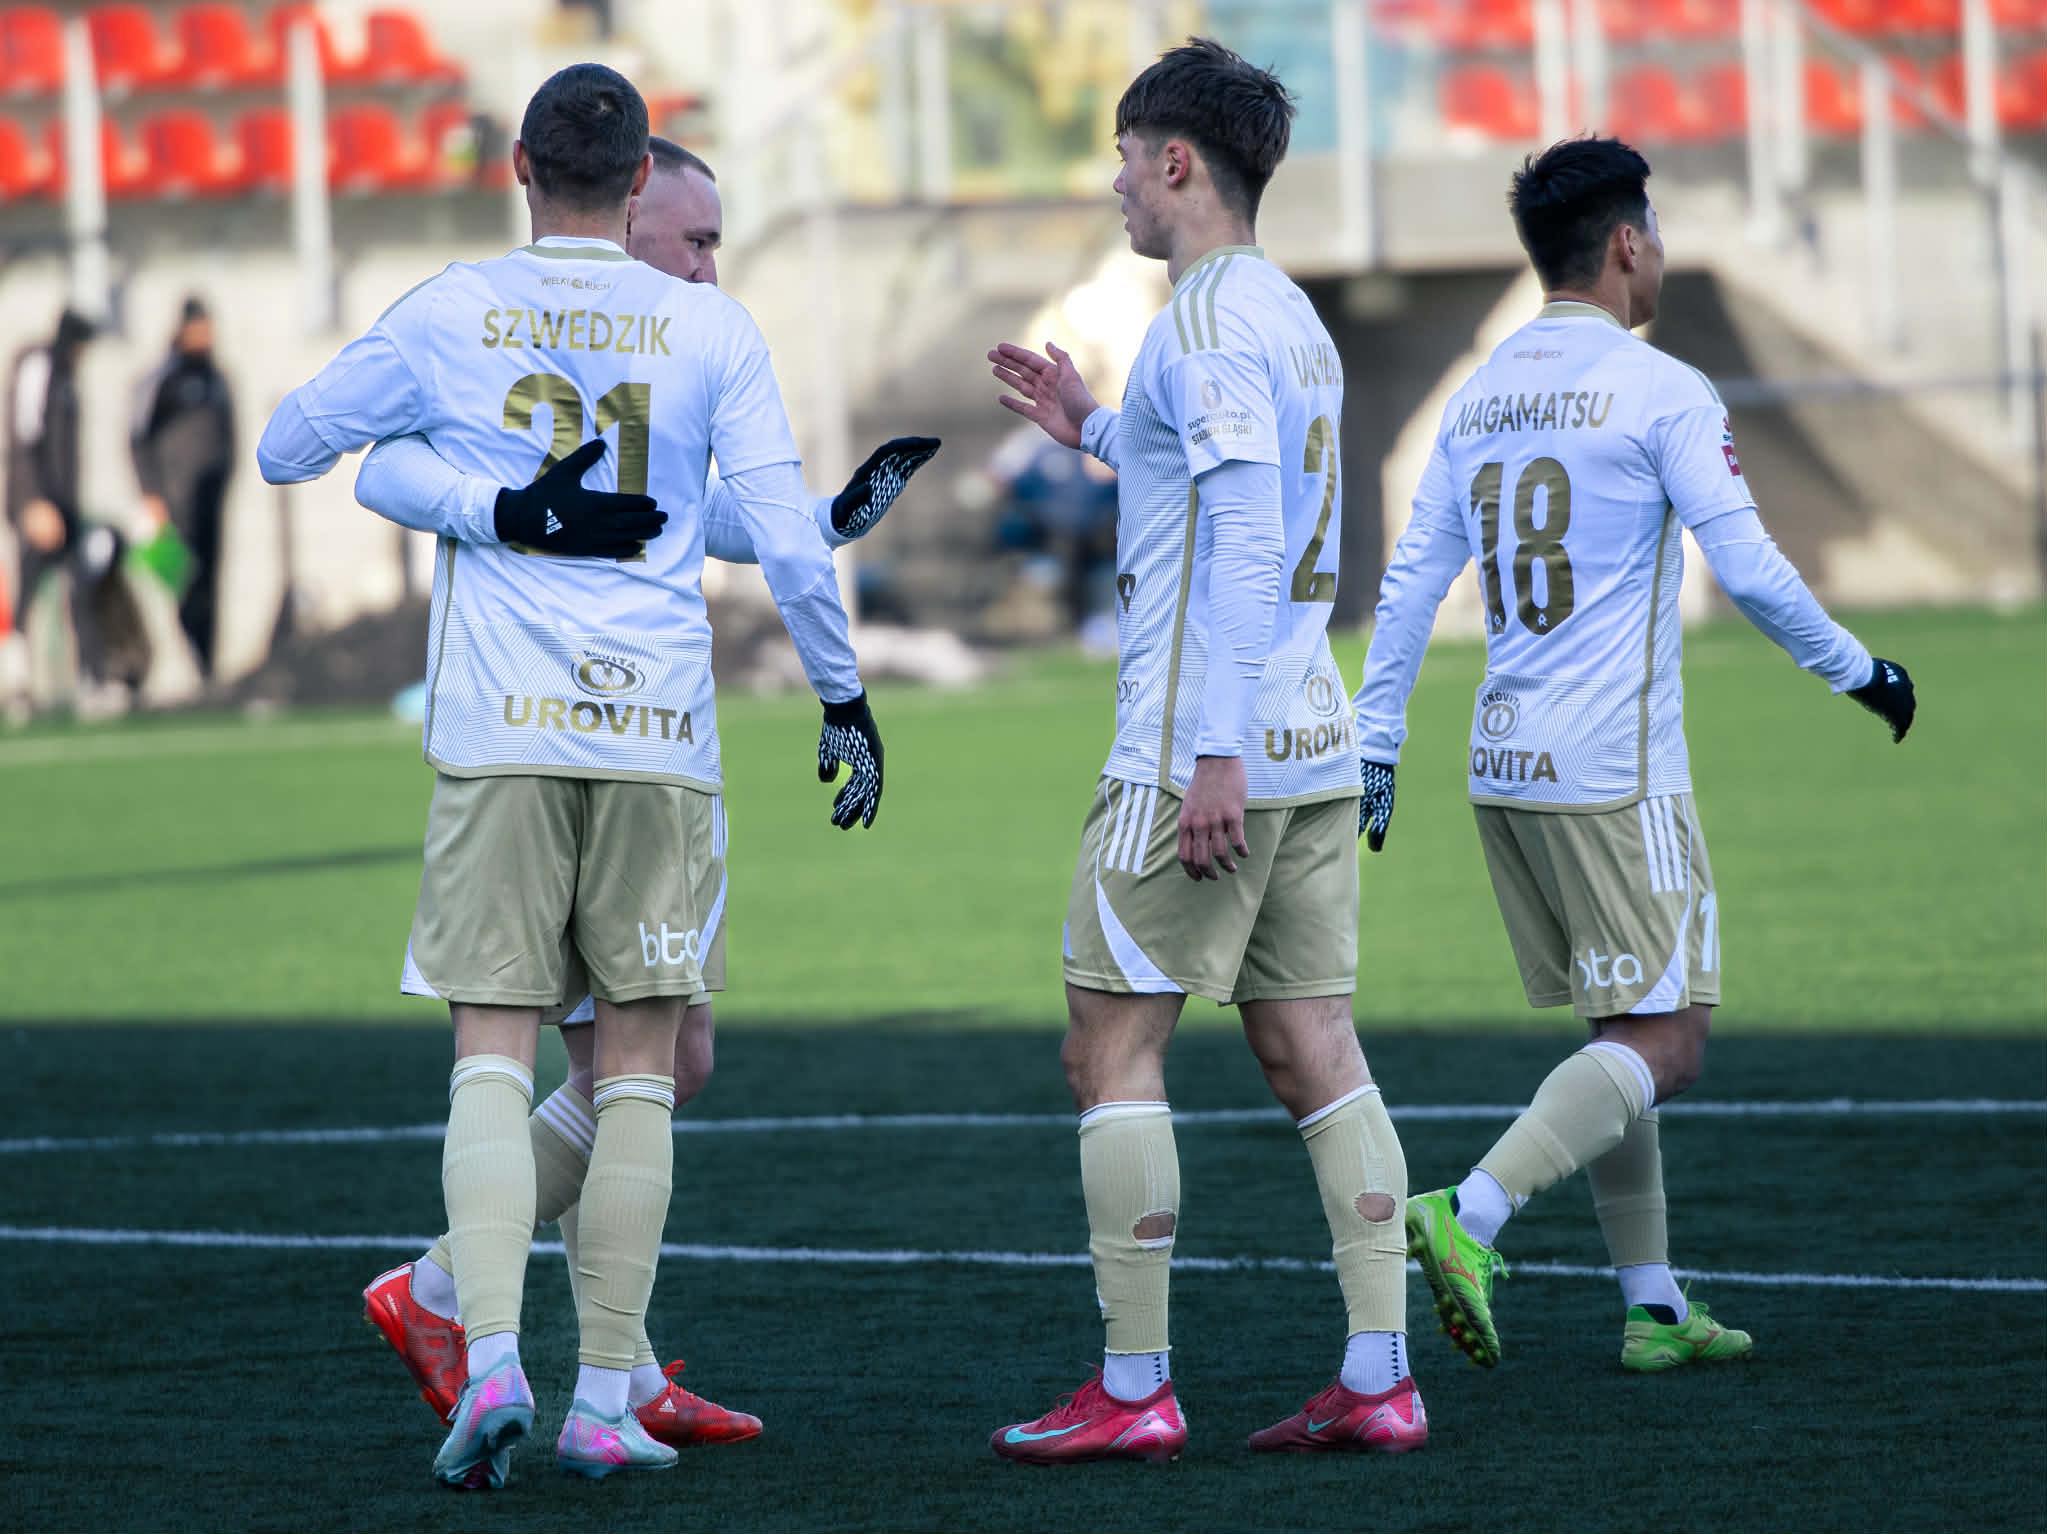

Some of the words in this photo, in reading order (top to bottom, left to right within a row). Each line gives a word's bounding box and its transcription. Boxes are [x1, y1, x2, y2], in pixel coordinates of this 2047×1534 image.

[481, 309, 672, 356] SZWEDZIK
[1451, 391, 1615, 438] NAGAMATSU
[501, 373, 652, 563] 21
[1289, 414, 1342, 603] 2
[1470, 456, 1575, 636] 18
[503, 695, 695, 745] UROVITA
[1264, 717, 1354, 762] UROVI
[1468, 744, 1558, 784] OVITA
